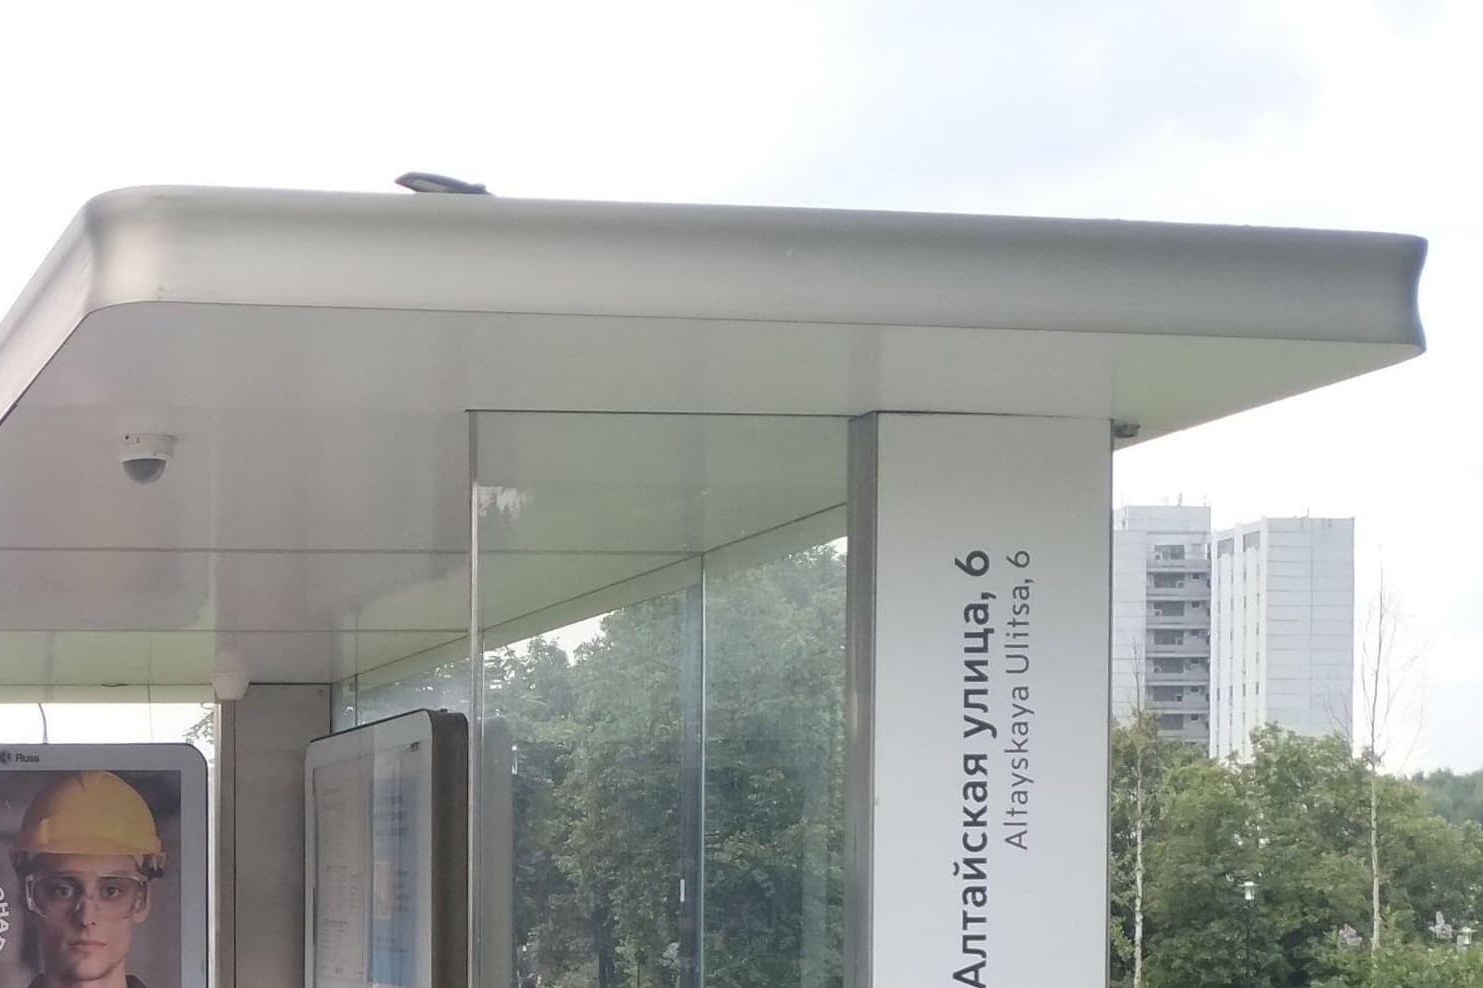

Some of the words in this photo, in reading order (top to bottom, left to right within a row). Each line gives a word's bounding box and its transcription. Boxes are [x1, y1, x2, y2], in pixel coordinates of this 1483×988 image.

[954, 549, 991, 577] 6
[1005, 549, 1031, 569] 6
[962, 592, 998, 738] улица,
[1004, 576, 1034, 674] Ulitsa,
[1003, 685, 1035, 850] Altayskaya
